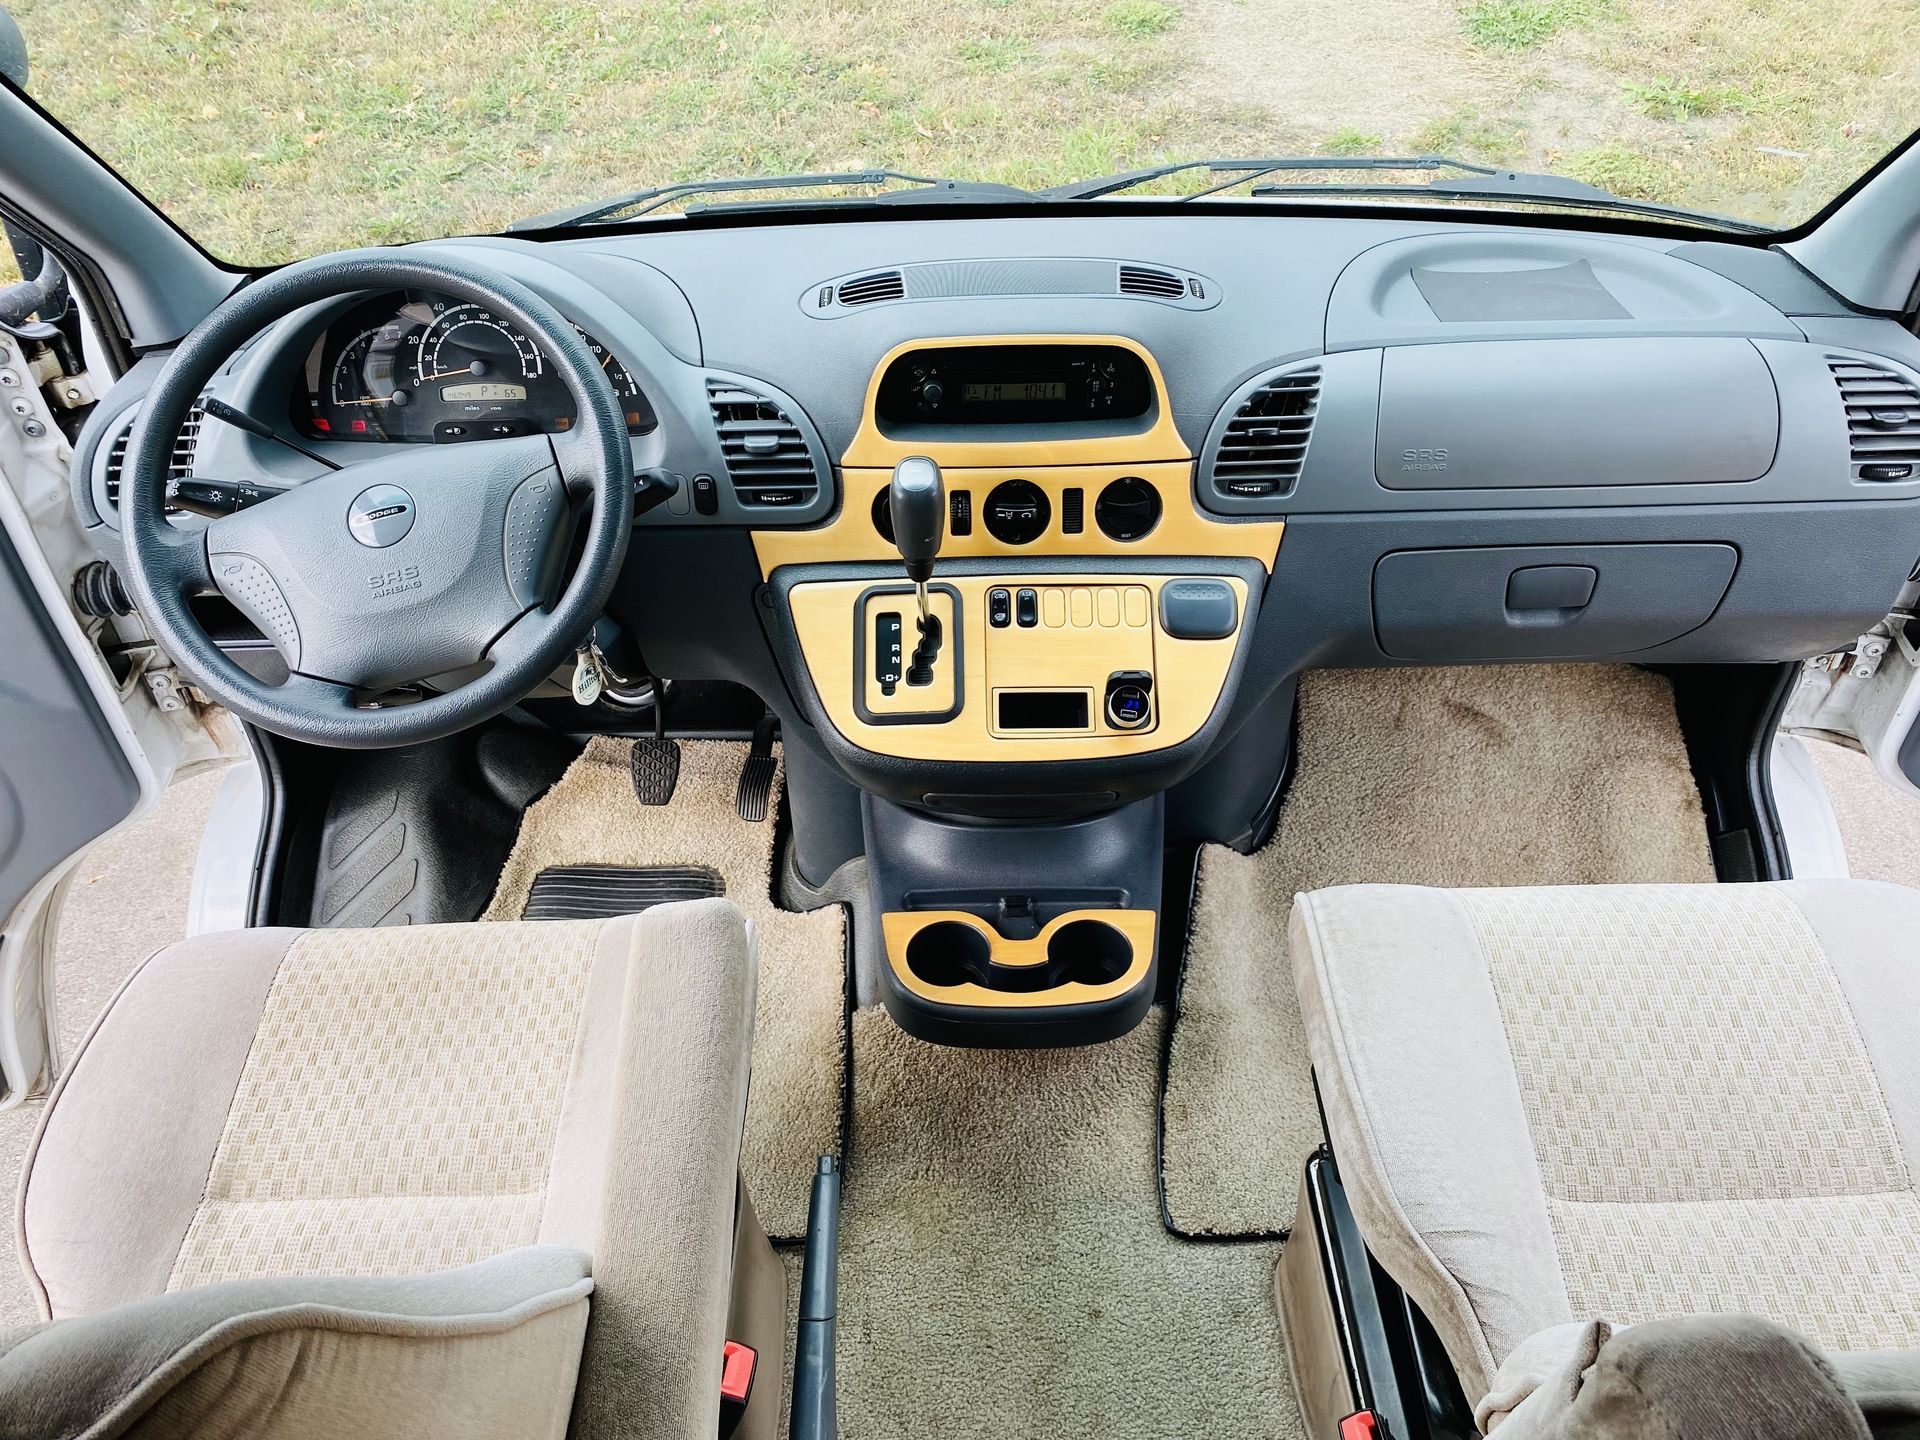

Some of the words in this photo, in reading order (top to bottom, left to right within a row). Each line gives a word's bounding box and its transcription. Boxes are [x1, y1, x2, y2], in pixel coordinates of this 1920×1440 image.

[433, 303, 445, 311] 40
[408, 335, 420, 345] 20
[349, 351, 356, 360] 3
[341, 366, 348, 374] 2
[413, 379, 420, 387] 0
[481, 385, 488, 397] P
[1403, 448, 1448, 461] SRS
[1401, 463, 1447, 472] AIRBAG
[362, 507, 399, 522] DODGE
[369, 566, 420, 590] SRS
[373, 580, 423, 600] AIRBAG
[891, 623, 900, 632] P
[891, 644, 900, 652] R
[891, 656, 901, 664] N
[578, 670, 601, 694] Hilltop
